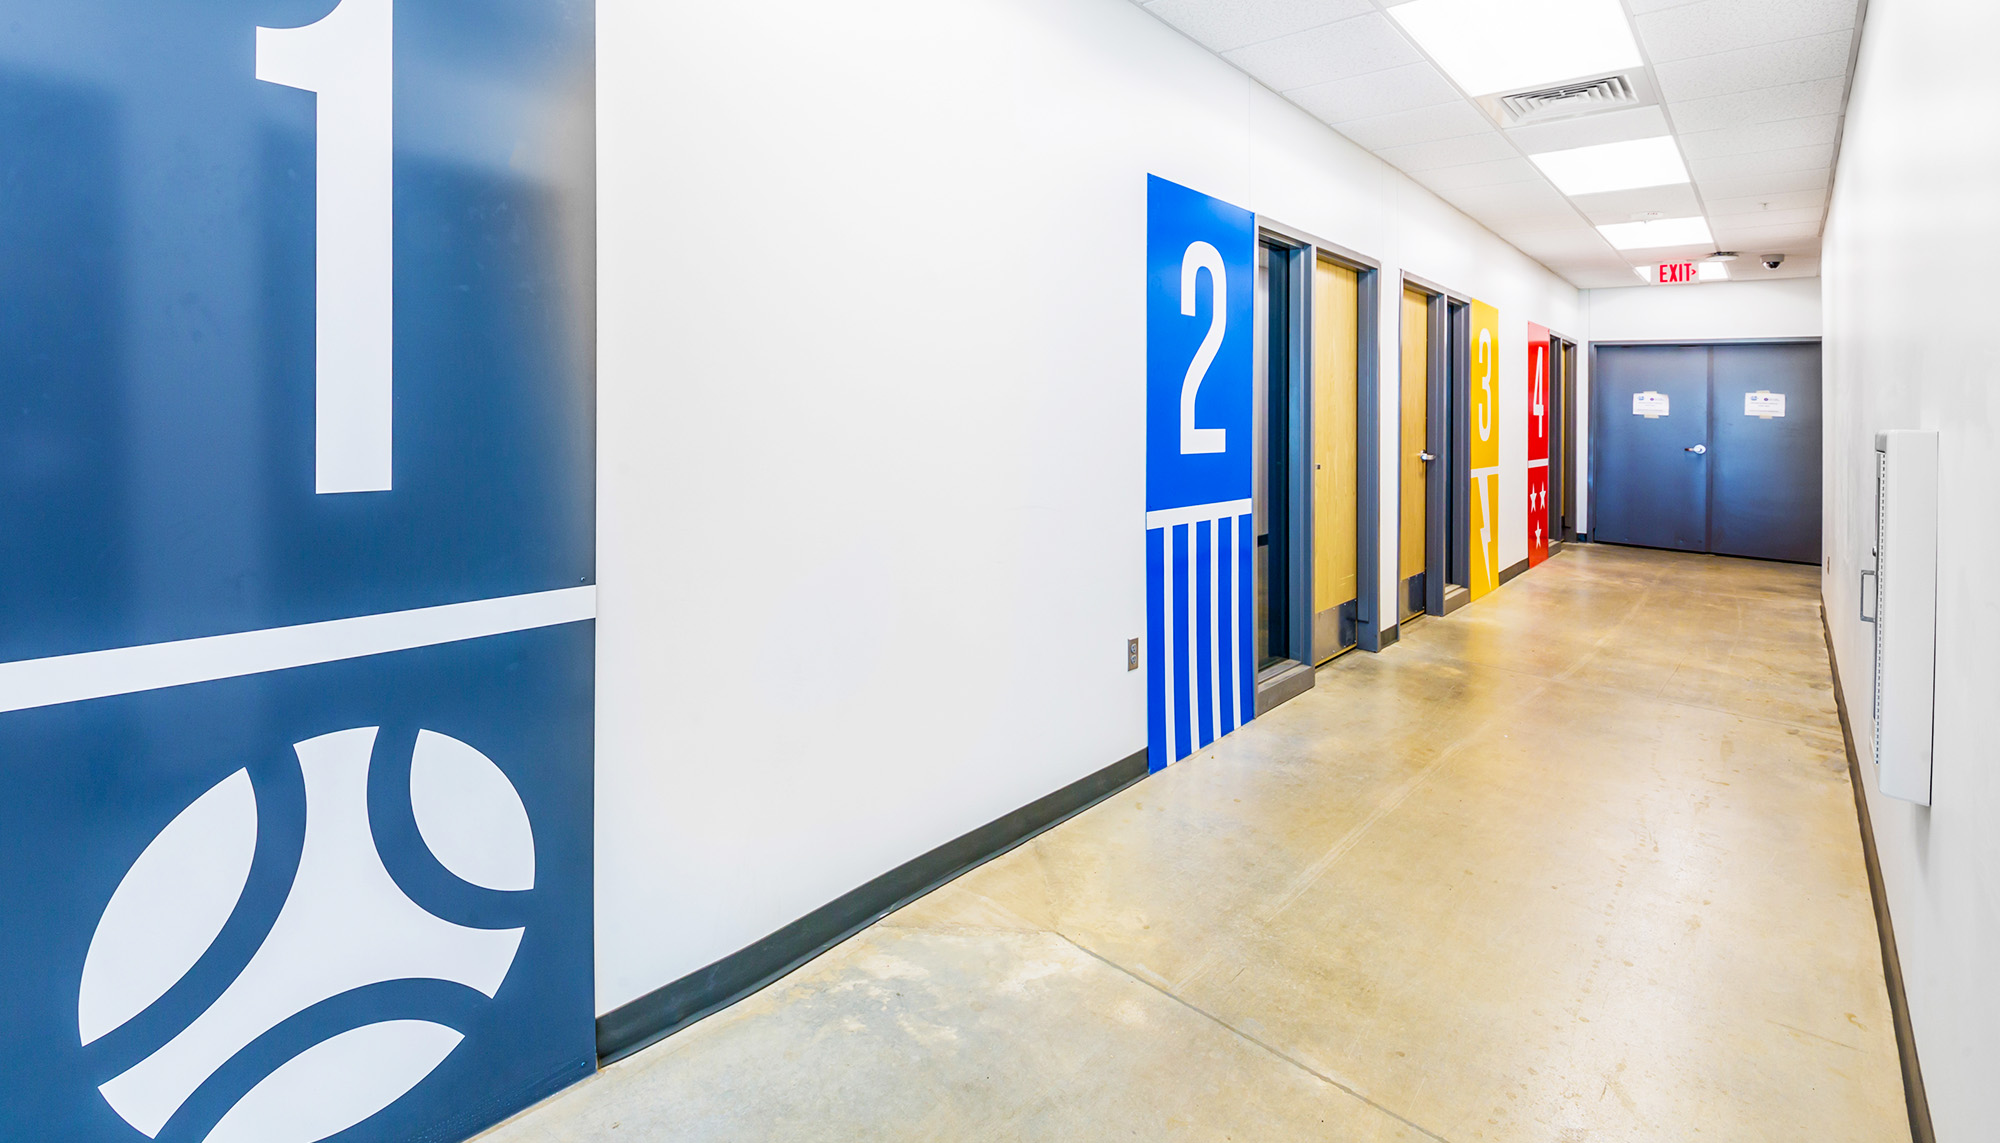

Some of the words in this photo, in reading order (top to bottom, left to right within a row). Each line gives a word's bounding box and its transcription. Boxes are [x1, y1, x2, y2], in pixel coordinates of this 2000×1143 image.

[256, 0, 393, 493] 1
[1659, 263, 1692, 283] EXIT
[1180, 240, 1227, 454] 2
[1478, 328, 1492, 441] 3
[1533, 346, 1544, 438] 4
